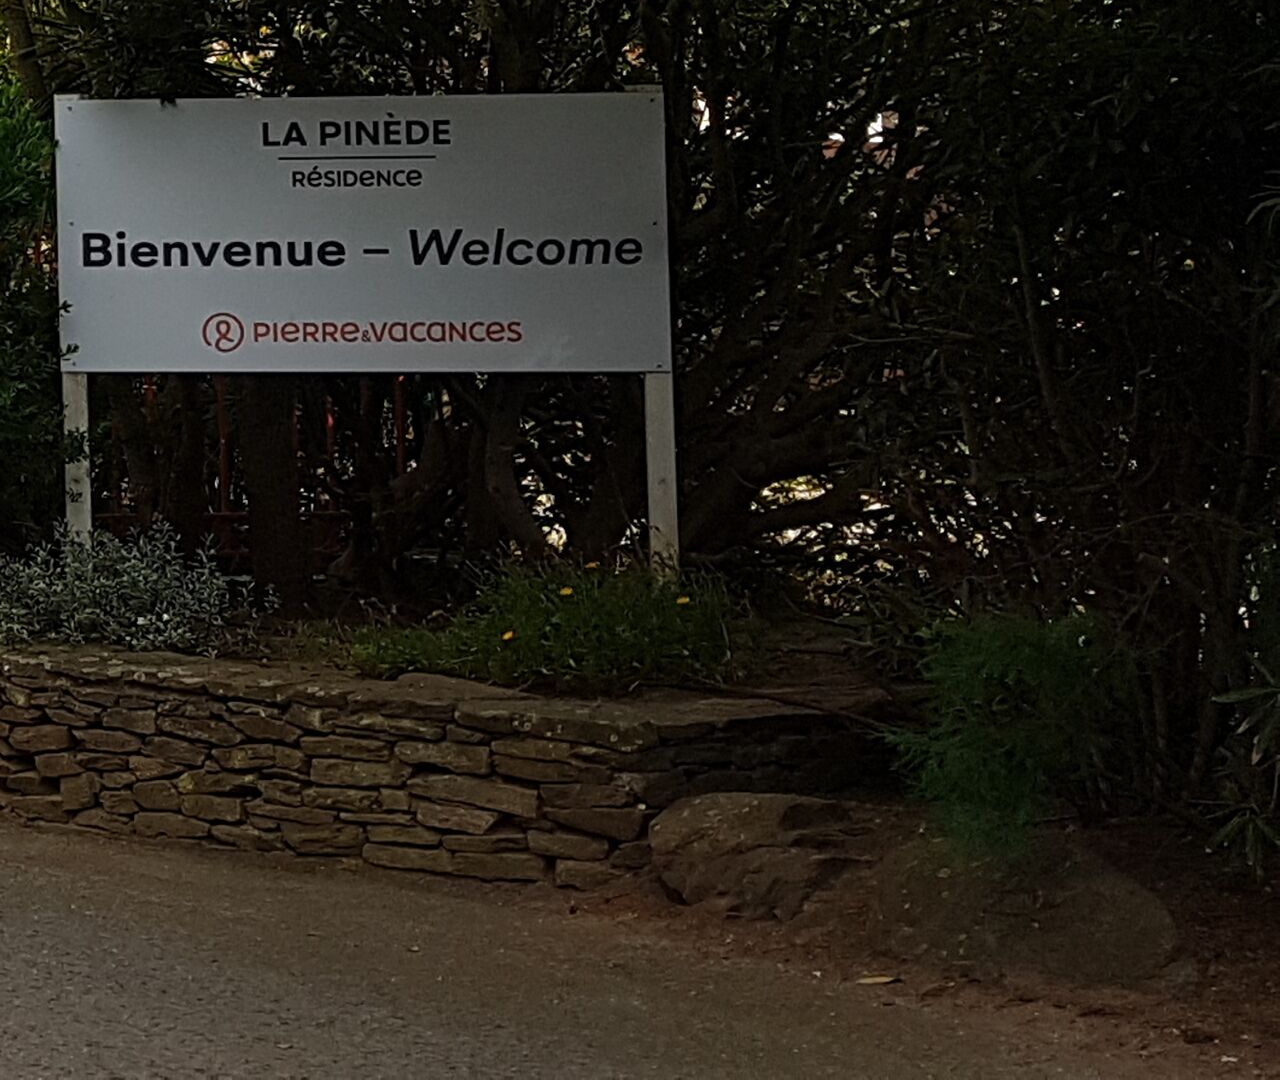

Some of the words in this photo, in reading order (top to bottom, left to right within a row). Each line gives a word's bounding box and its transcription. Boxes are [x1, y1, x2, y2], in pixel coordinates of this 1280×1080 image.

[261, 120, 308, 148] LA
[318, 111, 453, 147] PINÈDE
[81, 229, 347, 269] Bienvenue
[407, 226, 644, 267] Welcome
